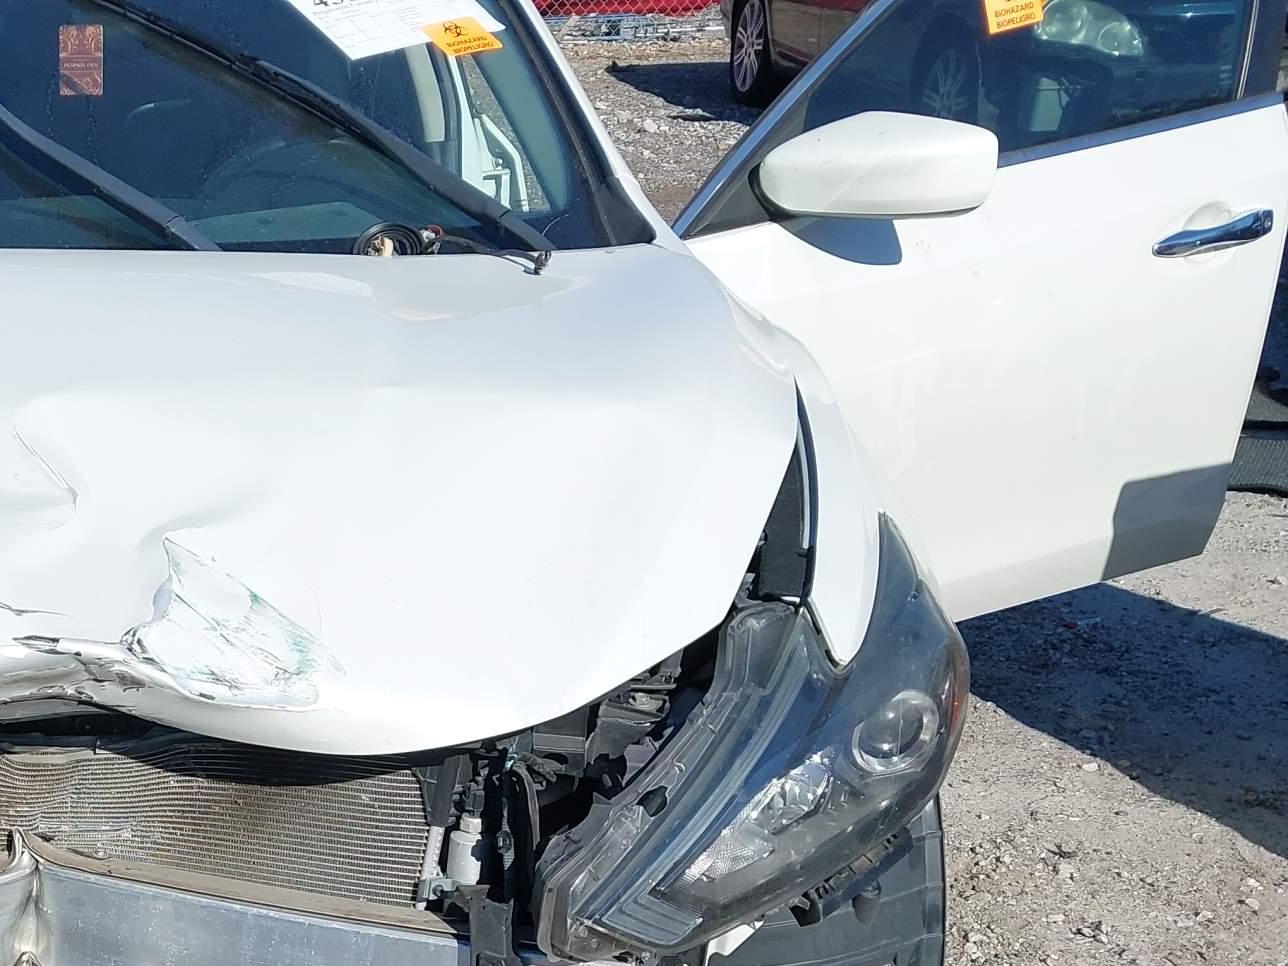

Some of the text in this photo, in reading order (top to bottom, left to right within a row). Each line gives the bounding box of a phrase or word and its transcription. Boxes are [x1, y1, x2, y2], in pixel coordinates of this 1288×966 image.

[995, 2, 1033, 18] BIOHAZARD
[997, 12, 1036, 28] BIOPELIGRO
[446, 36, 488, 48] BIOHAZARD
